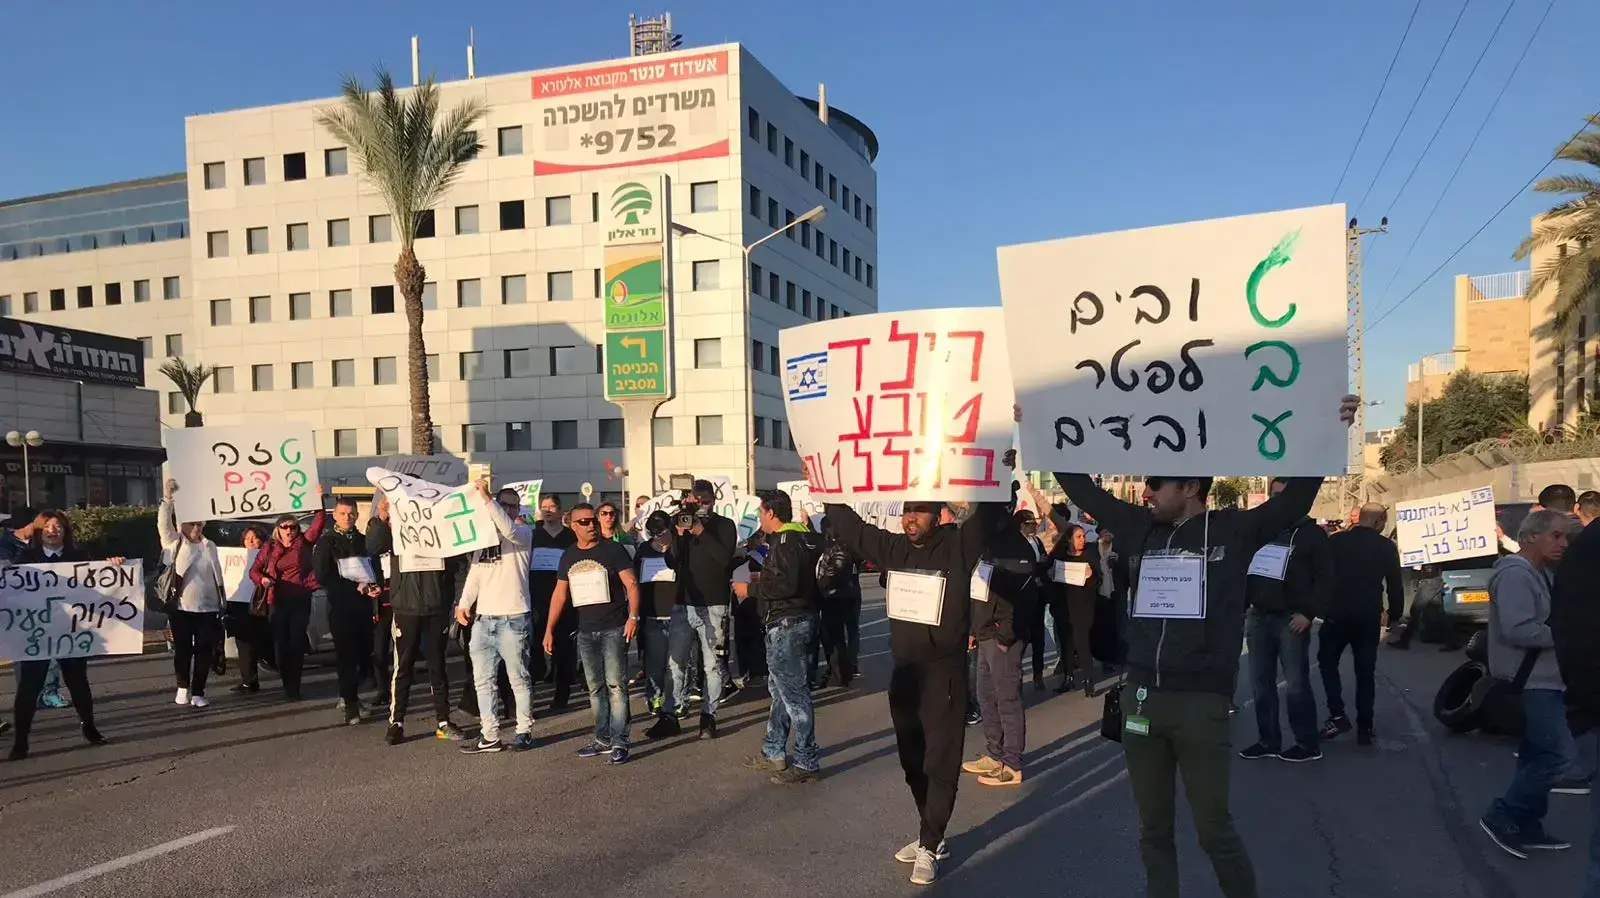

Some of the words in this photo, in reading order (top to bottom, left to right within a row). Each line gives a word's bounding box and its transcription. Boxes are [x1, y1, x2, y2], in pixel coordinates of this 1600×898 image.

[629, 64, 666, 82] סנטר
[669, 57, 718, 76] אשדוד
[540, 76, 582, 94] אלעזרא
[585, 71, 629, 89] מקבוצת
[543, 92, 627, 127] להשכרה
[632, 87, 716, 117] משרדים
[608, 228, 636, 242] אלון
[638, 227, 657, 237] דור
[610, 309, 660, 325] אלונית
[612, 362, 659, 376] הכניסה
[615, 378, 658, 392] מסביב
[210, 486, 272, 515] שלנו
[1421, 516, 1469, 539] טבע
[1424, 538, 1451, 563] לבן
[1457, 535, 1487, 552] כחול
[66, 563, 135, 589] מפעל
[71, 596, 138, 633] זקוק
[25, 627, 95, 657] דחוף
